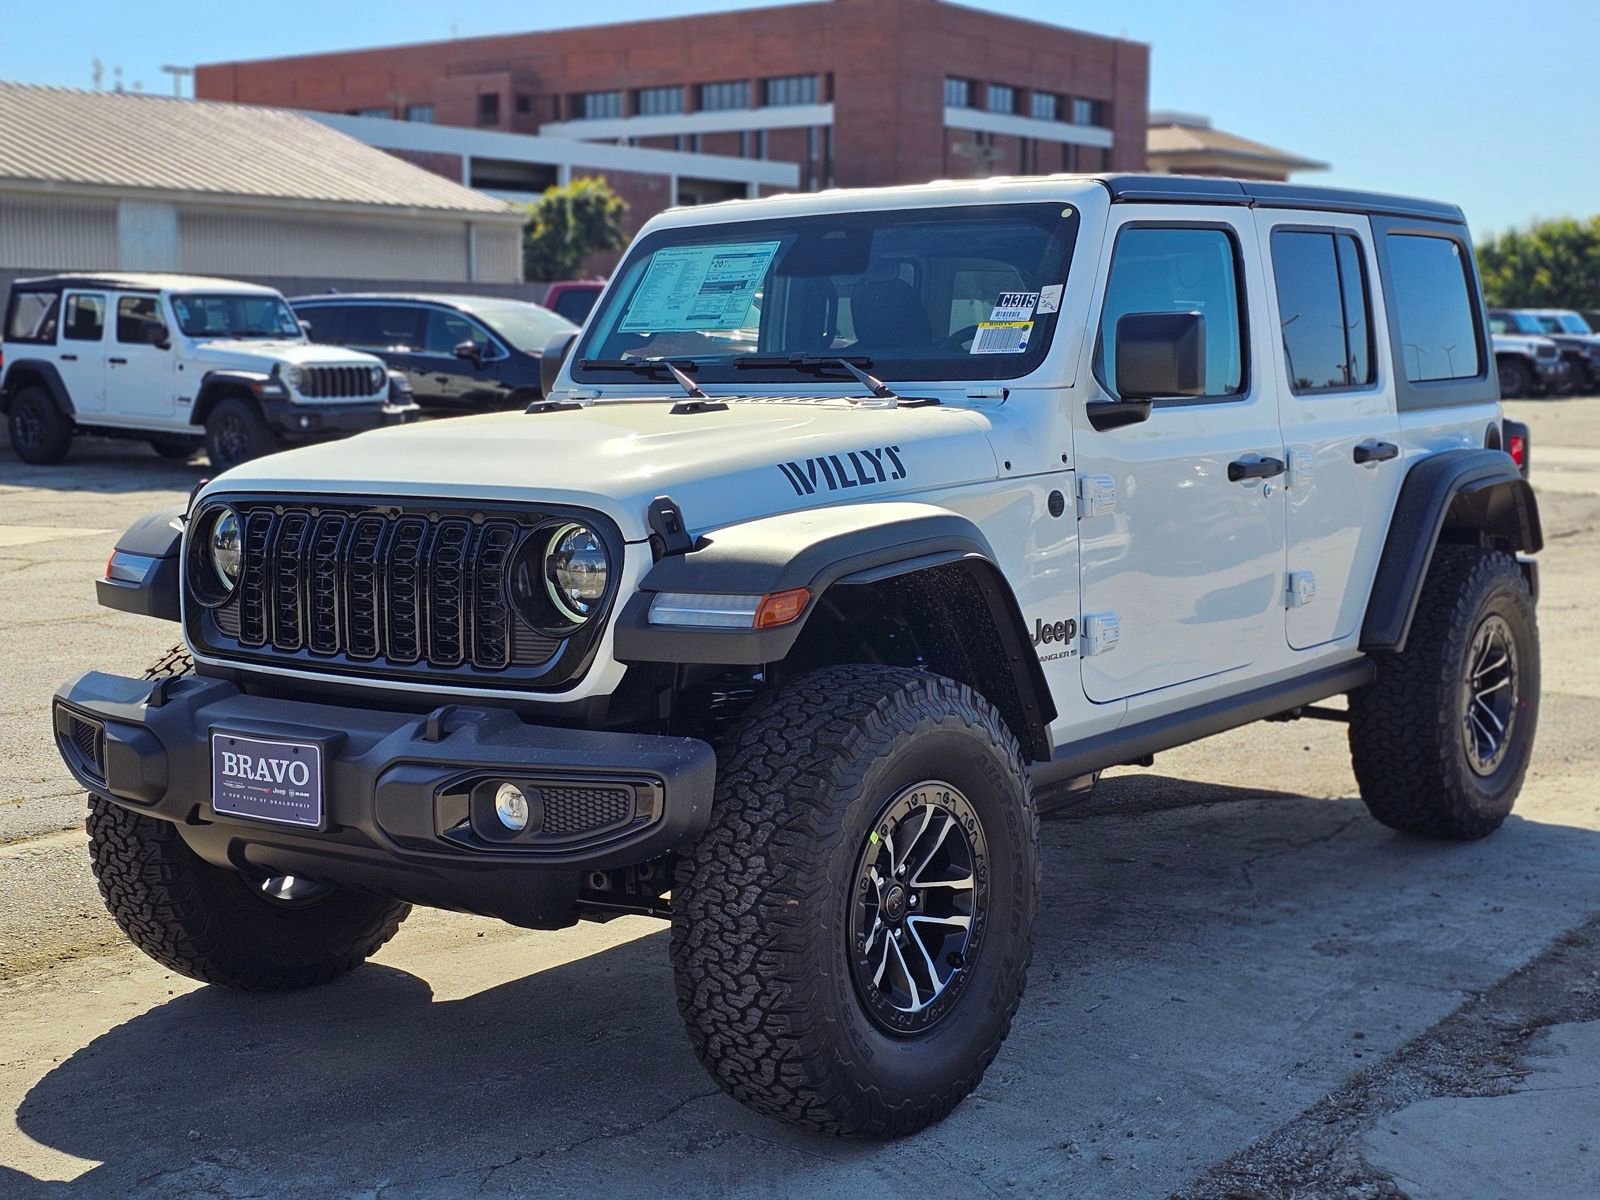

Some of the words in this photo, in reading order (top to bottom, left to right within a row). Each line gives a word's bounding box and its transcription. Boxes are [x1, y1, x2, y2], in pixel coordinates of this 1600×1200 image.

[1002, 295, 1036, 306] C13115
[777, 446, 906, 496] WILLYS
[1030, 618, 1077, 647] Jeep
[1039, 650, 1070, 662] ANGLER
[222, 752, 309, 786] BRAVO
